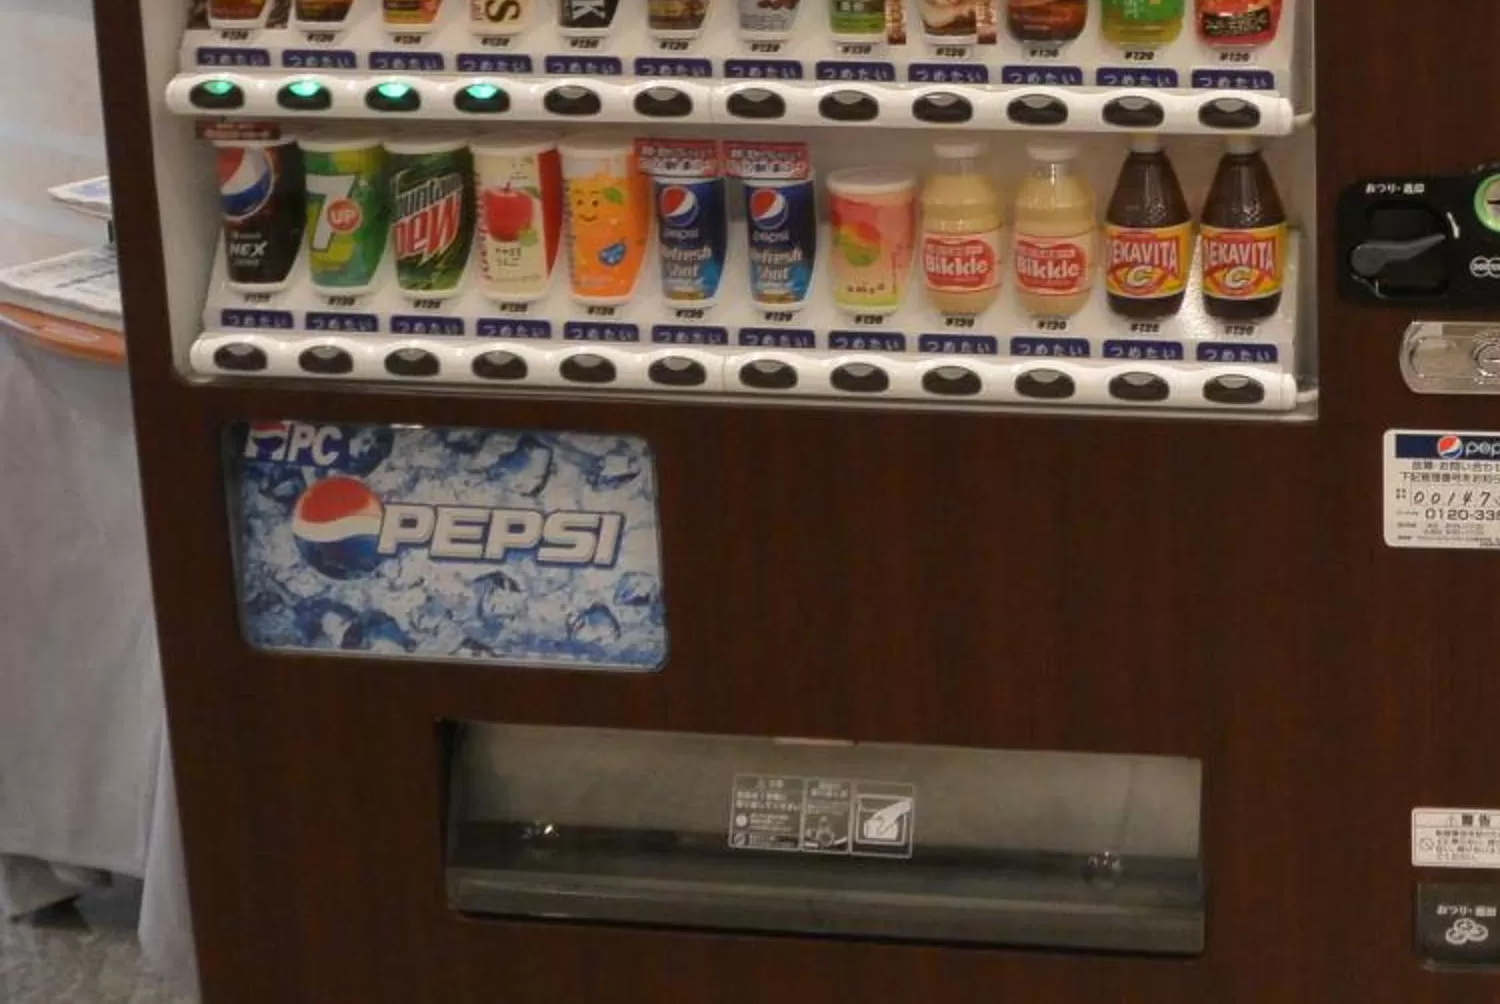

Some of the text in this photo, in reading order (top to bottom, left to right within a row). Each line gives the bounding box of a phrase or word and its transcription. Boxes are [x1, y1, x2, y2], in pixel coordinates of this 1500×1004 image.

[925, 257, 989, 278] Bikkle
[1017, 258, 1081, 280] Bikkle
[377, 503, 625, 567] PEPSI
